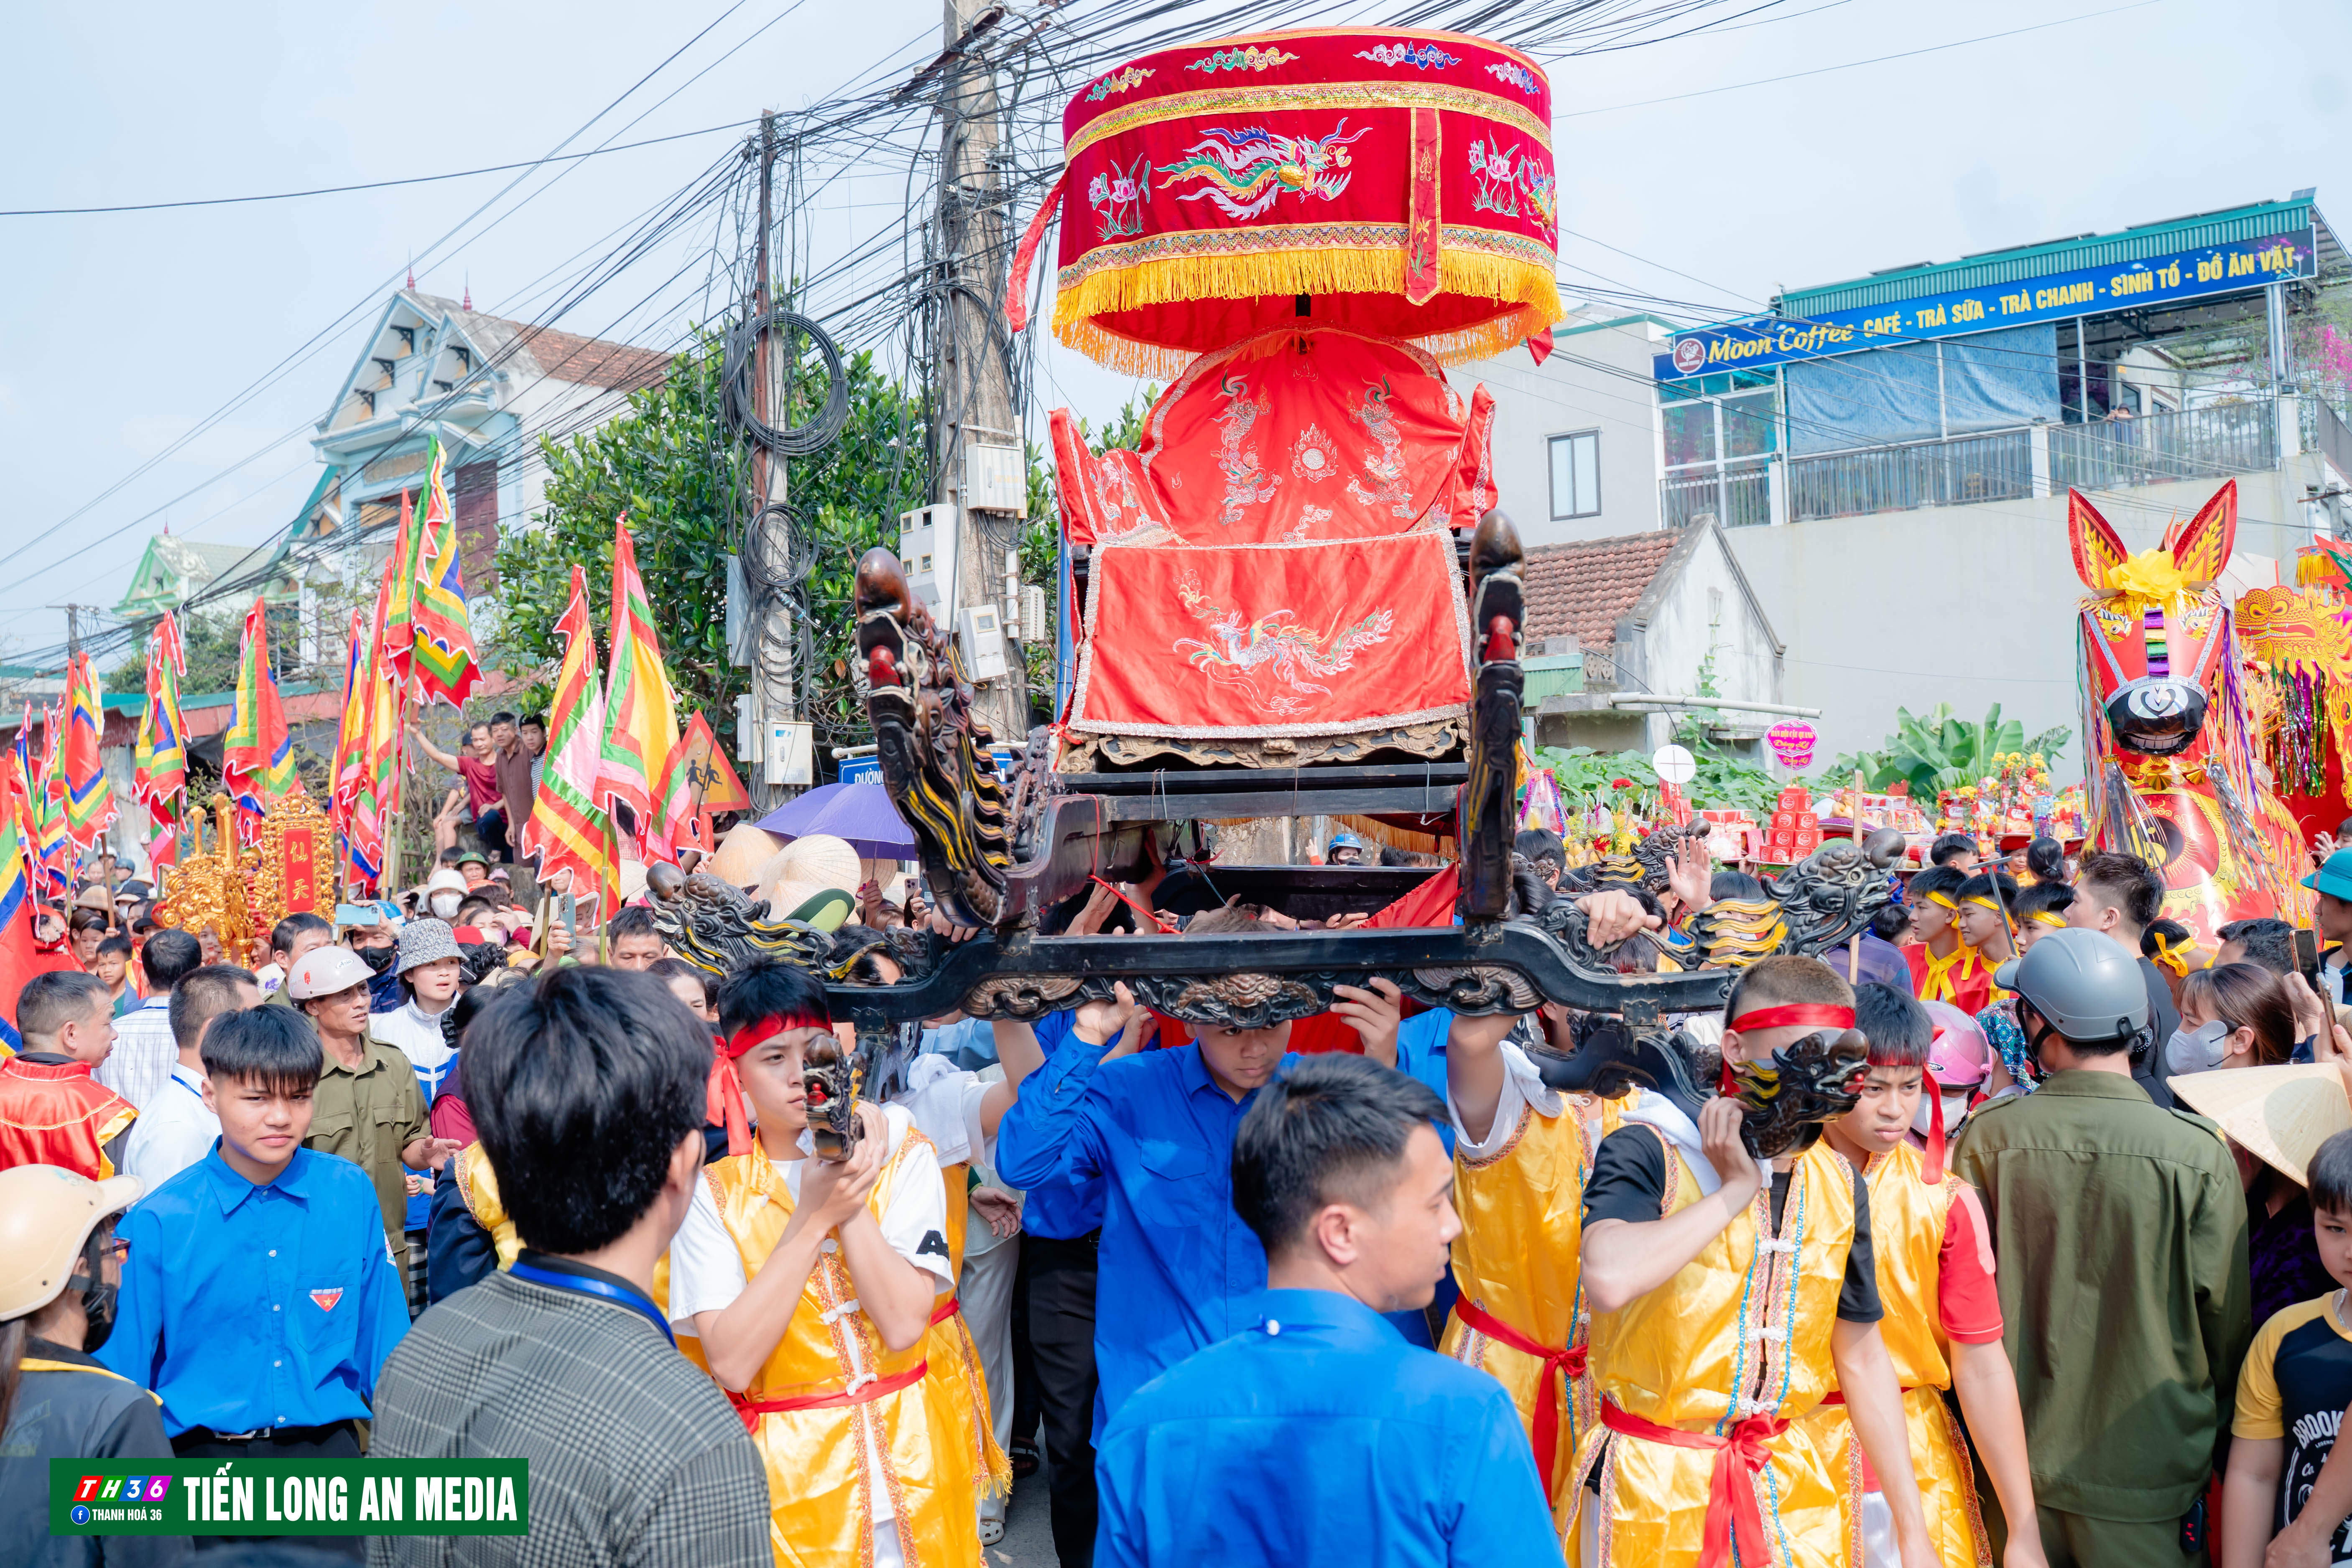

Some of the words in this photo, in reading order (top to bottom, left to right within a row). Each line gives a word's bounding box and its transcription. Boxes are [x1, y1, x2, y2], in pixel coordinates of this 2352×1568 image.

[1708, 337, 1772, 363] Moon
[1778, 322, 1855, 351] Coffee
[1863, 311, 1901, 338] CAFÉ
[1916, 303, 1947, 329] TRÀ
[1951, 299, 1985, 324] SỮA
[2000, 290, 2032, 315] TRÀ
[2036, 281, 2094, 310] CHANH
[2110, 271, 2153, 297] SINH
[2158, 259, 2180, 289] TỐ
[2197, 252, 2223, 282] ĐỒ
[2228, 252, 2255, 278] ĂN
[2260, 244, 2295, 274] VẶT
